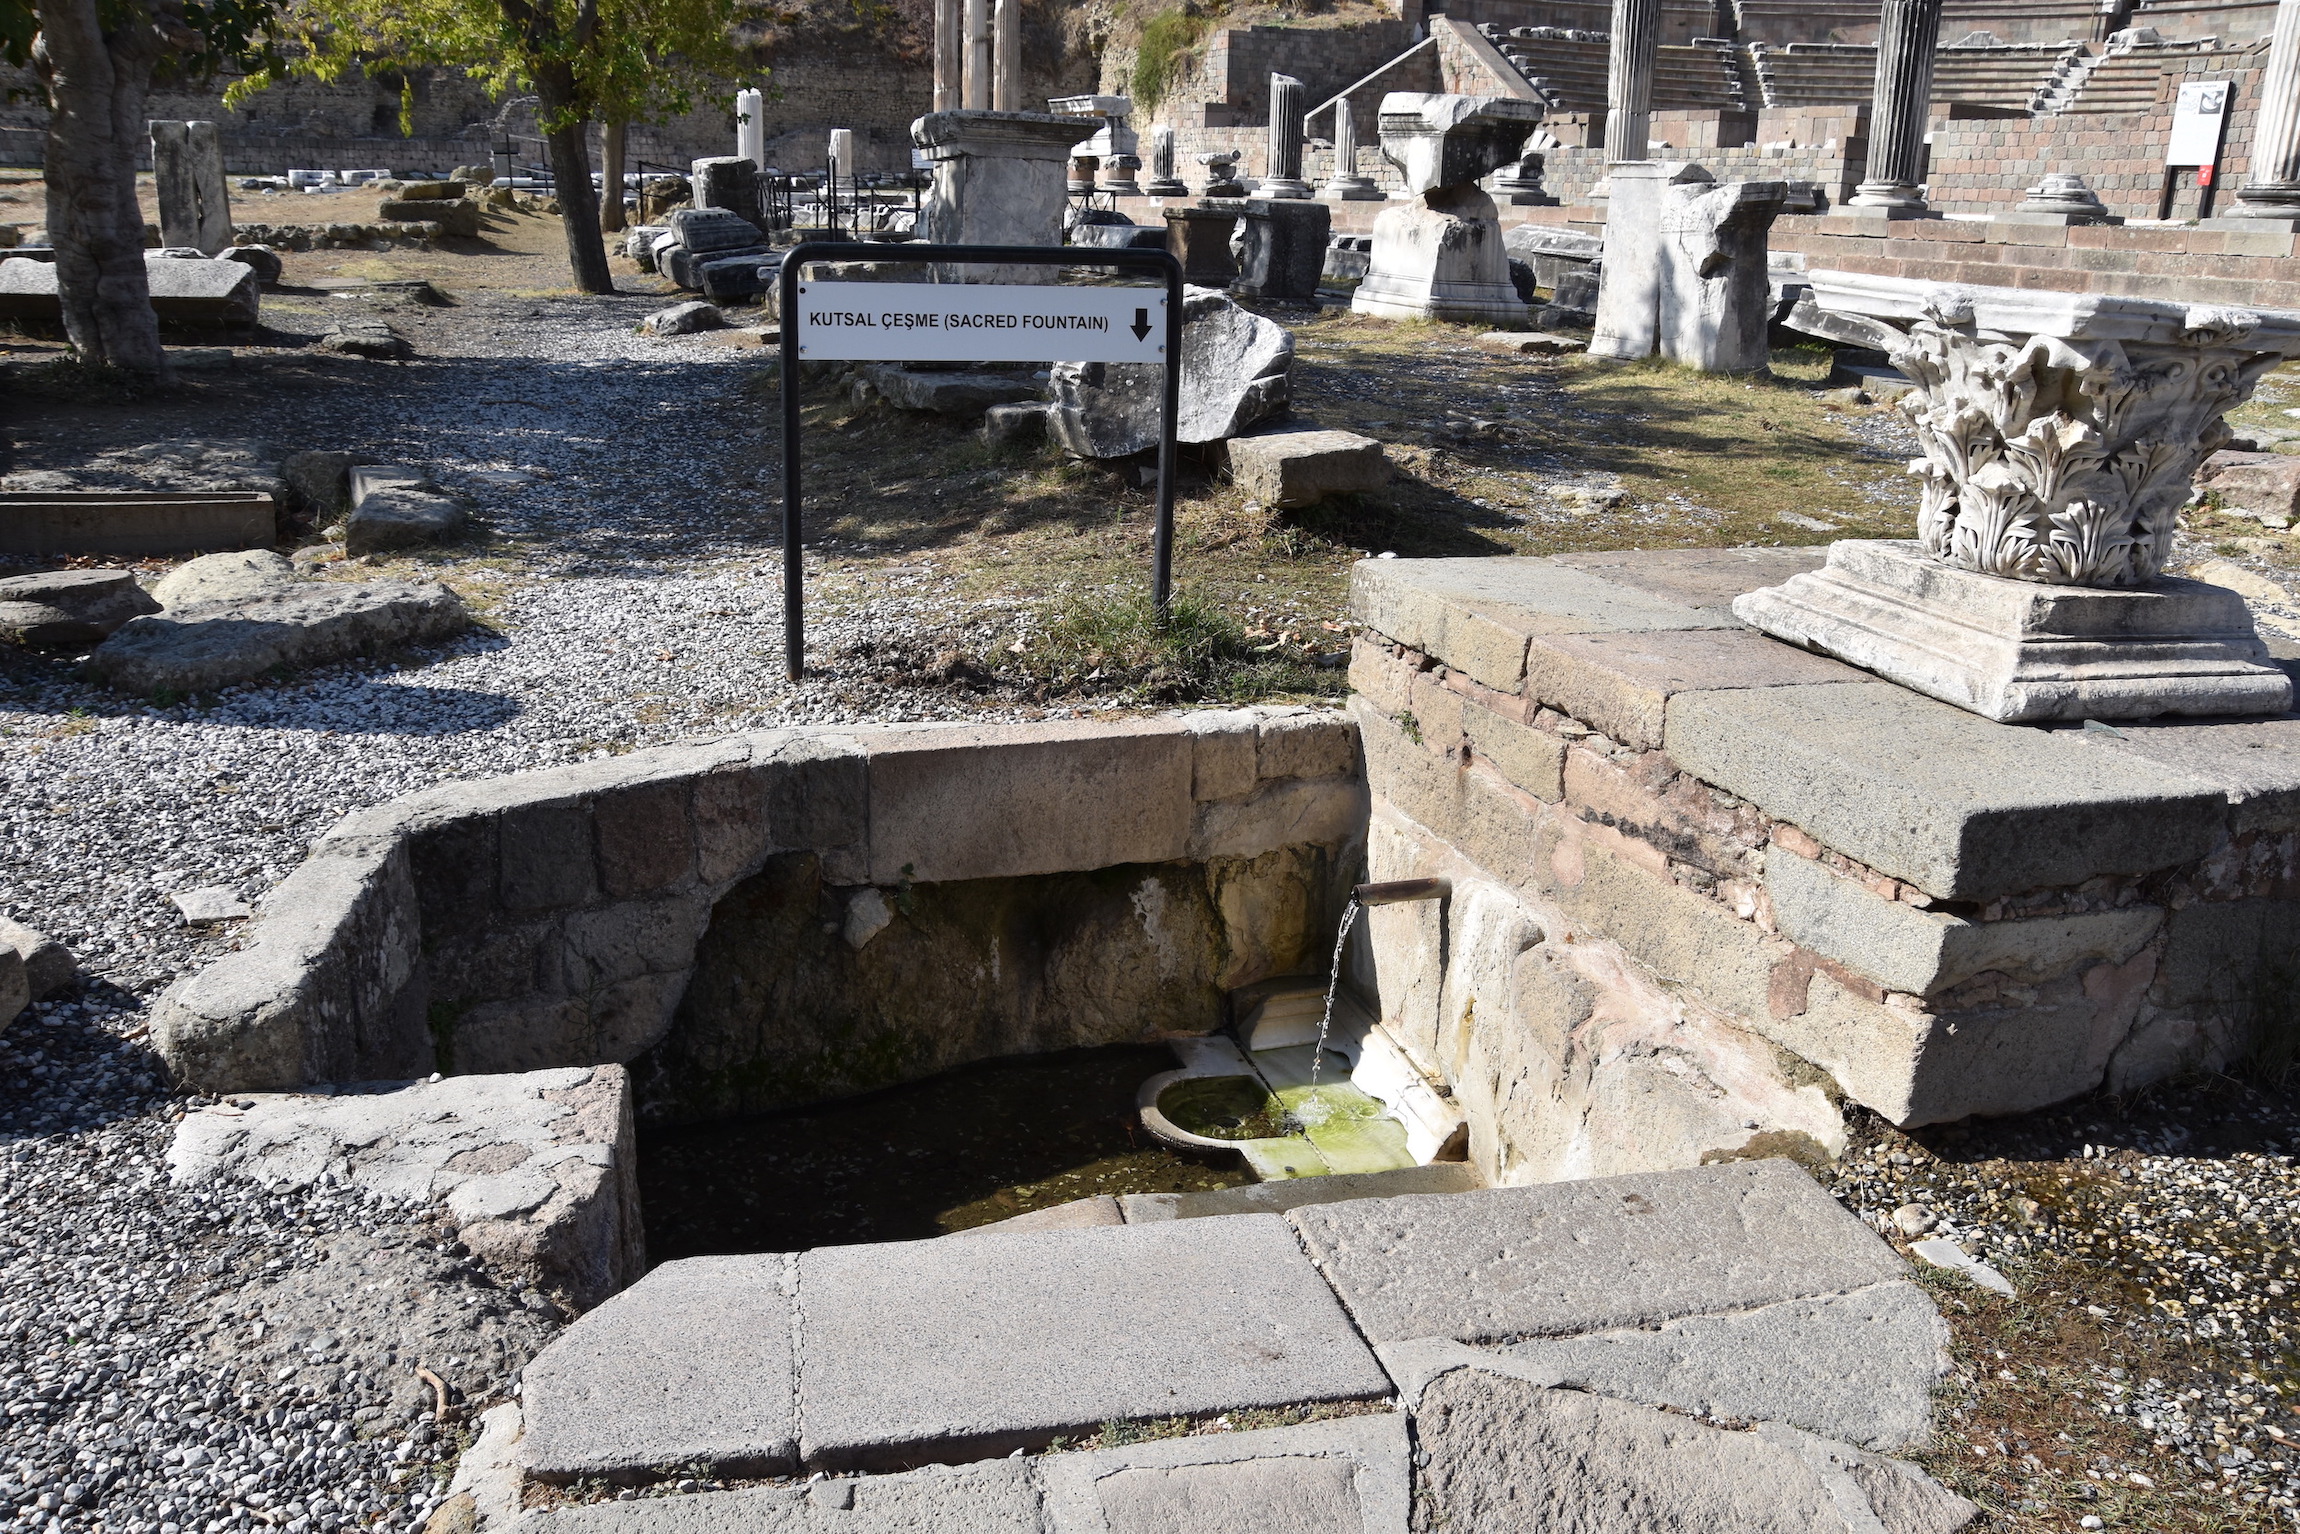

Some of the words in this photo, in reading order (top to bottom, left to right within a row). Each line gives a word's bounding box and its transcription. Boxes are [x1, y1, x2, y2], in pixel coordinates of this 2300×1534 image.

[809, 312, 877, 327] KUTSAL
[882, 312, 939, 331] ÇEŞME
[944, 313, 1018, 331] (SACRED
[1022, 314, 1109, 333] FOUNTAIN)
